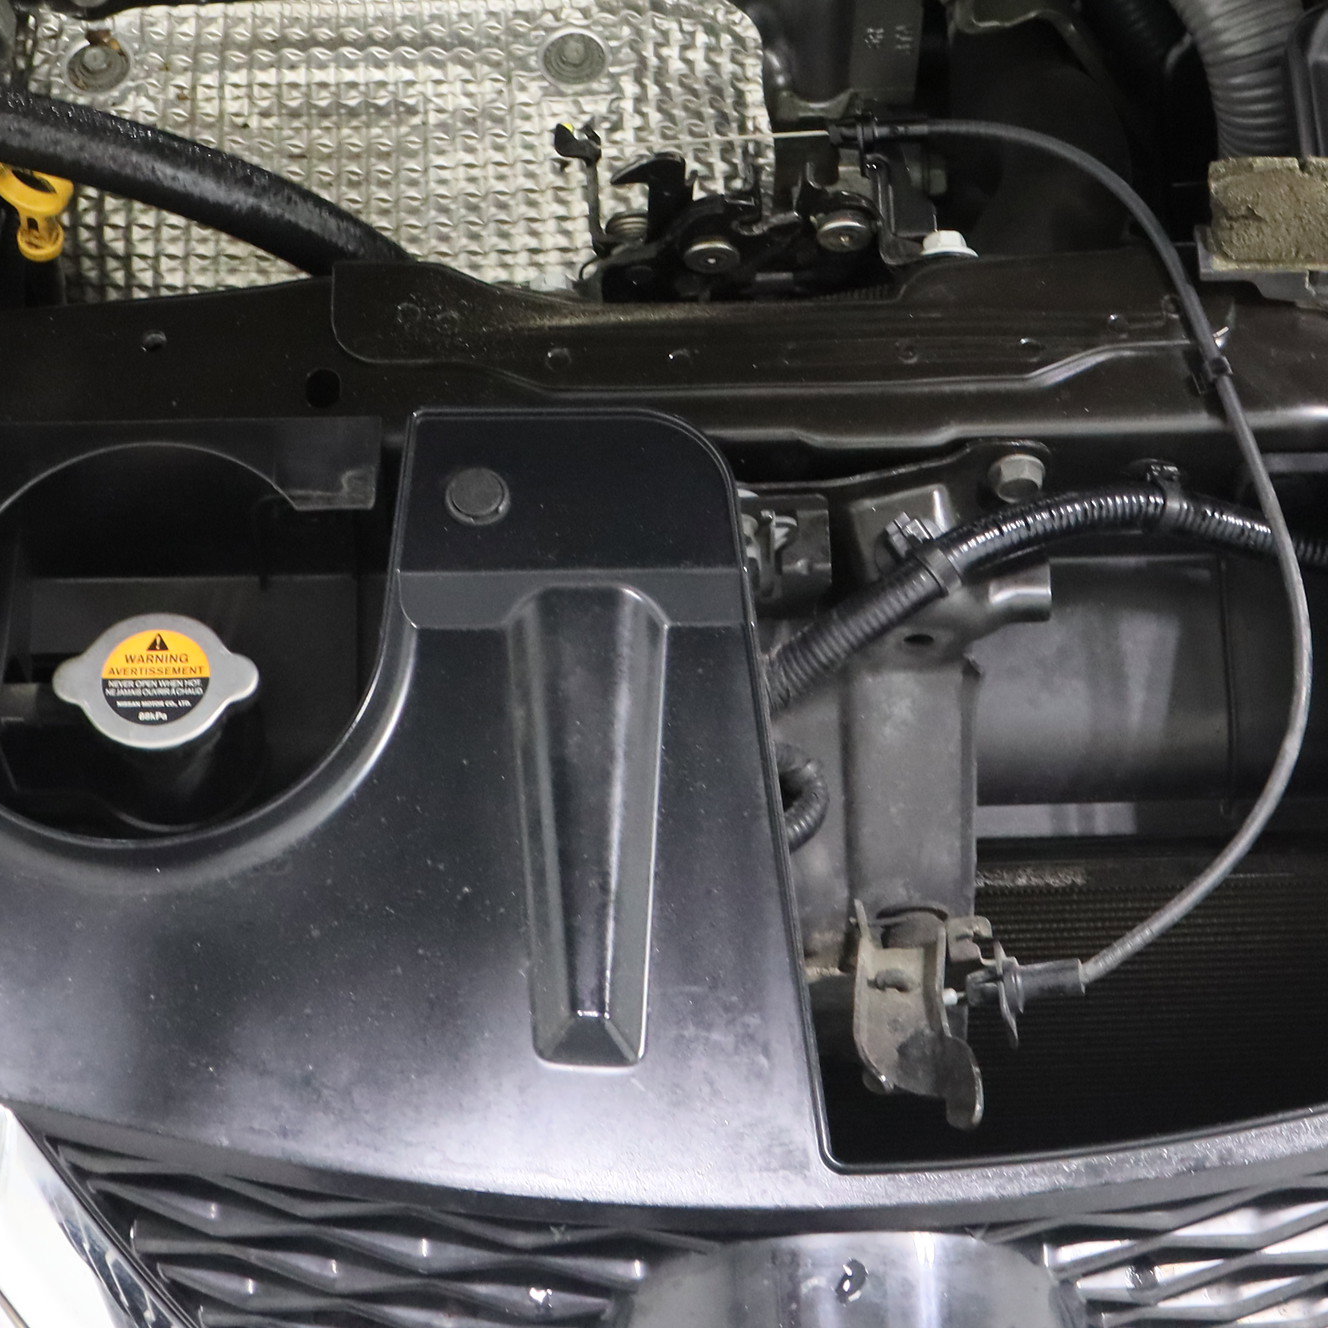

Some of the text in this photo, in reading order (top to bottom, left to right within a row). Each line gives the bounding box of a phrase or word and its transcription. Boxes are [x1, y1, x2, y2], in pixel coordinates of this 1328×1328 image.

[124, 653, 189, 664] WARNING
[108, 666, 205, 676] AVERTISSEMENT
[107, 680, 135, 688] NEVER
[135, 680, 158, 688] OPEN
[158, 679, 184, 687] WHEN
[105, 688, 117, 696] NE
